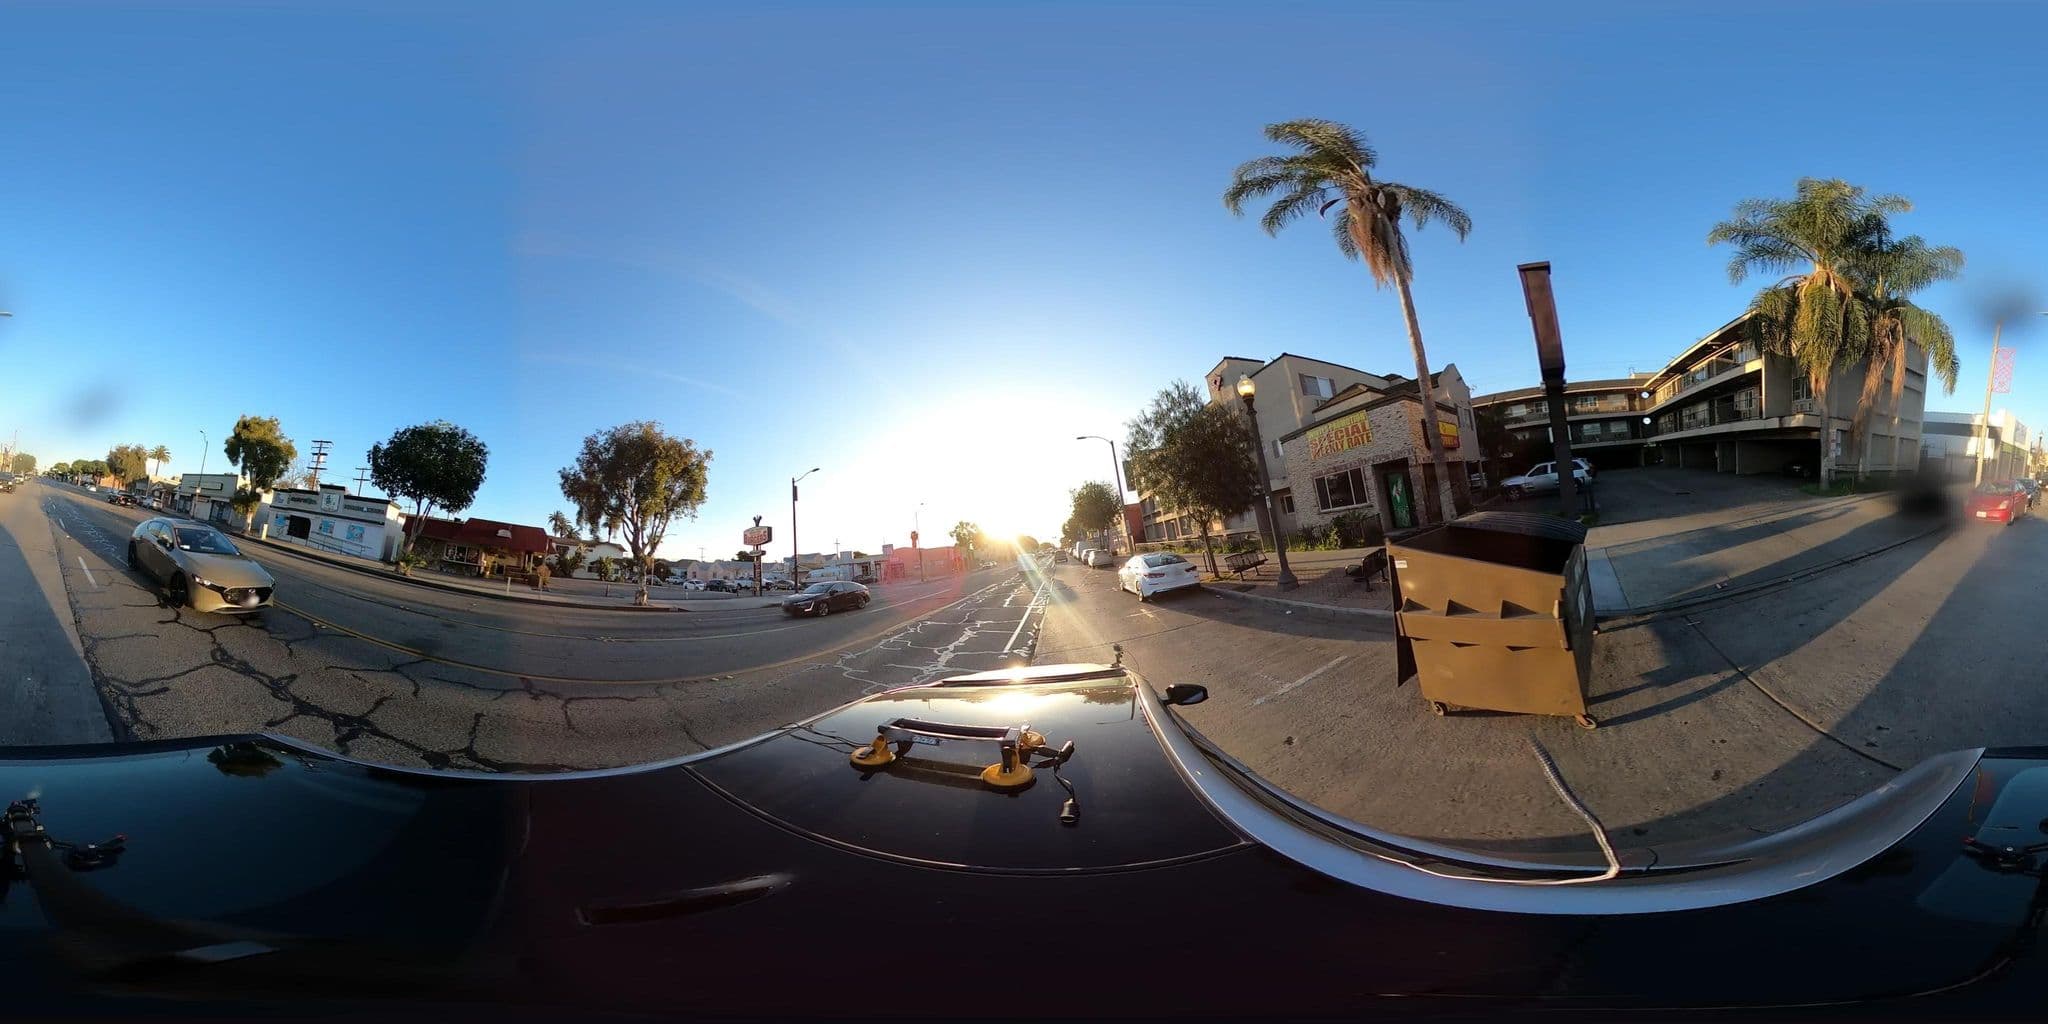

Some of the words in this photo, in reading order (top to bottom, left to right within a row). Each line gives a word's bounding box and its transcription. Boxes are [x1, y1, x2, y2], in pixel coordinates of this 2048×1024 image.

[1311, 420, 1370, 448] SPECIAL
[1312, 439, 1345, 460] WEEKLY
[1347, 432, 1372, 449] RATE
